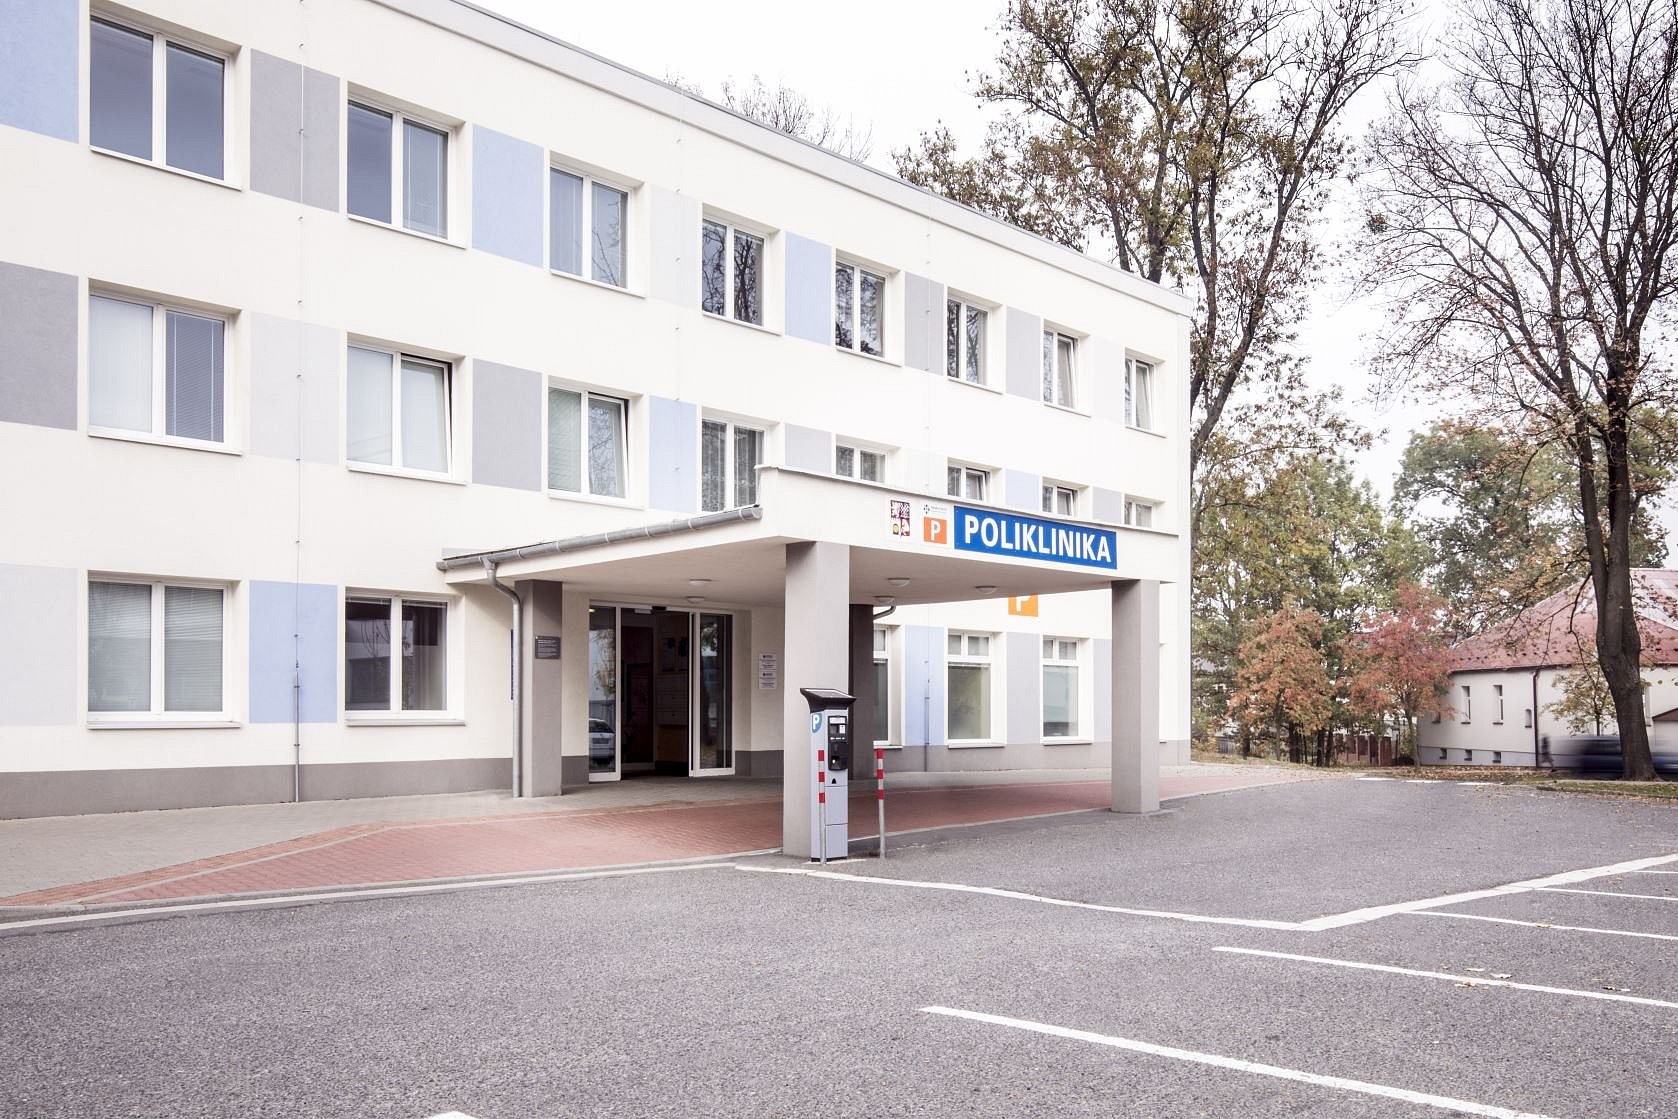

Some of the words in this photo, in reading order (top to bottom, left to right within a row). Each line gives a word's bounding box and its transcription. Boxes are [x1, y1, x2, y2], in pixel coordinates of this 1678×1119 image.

[931, 520, 941, 541] P
[965, 514, 1111, 562] POLIKLINIKA
[813, 715, 820, 730] P
